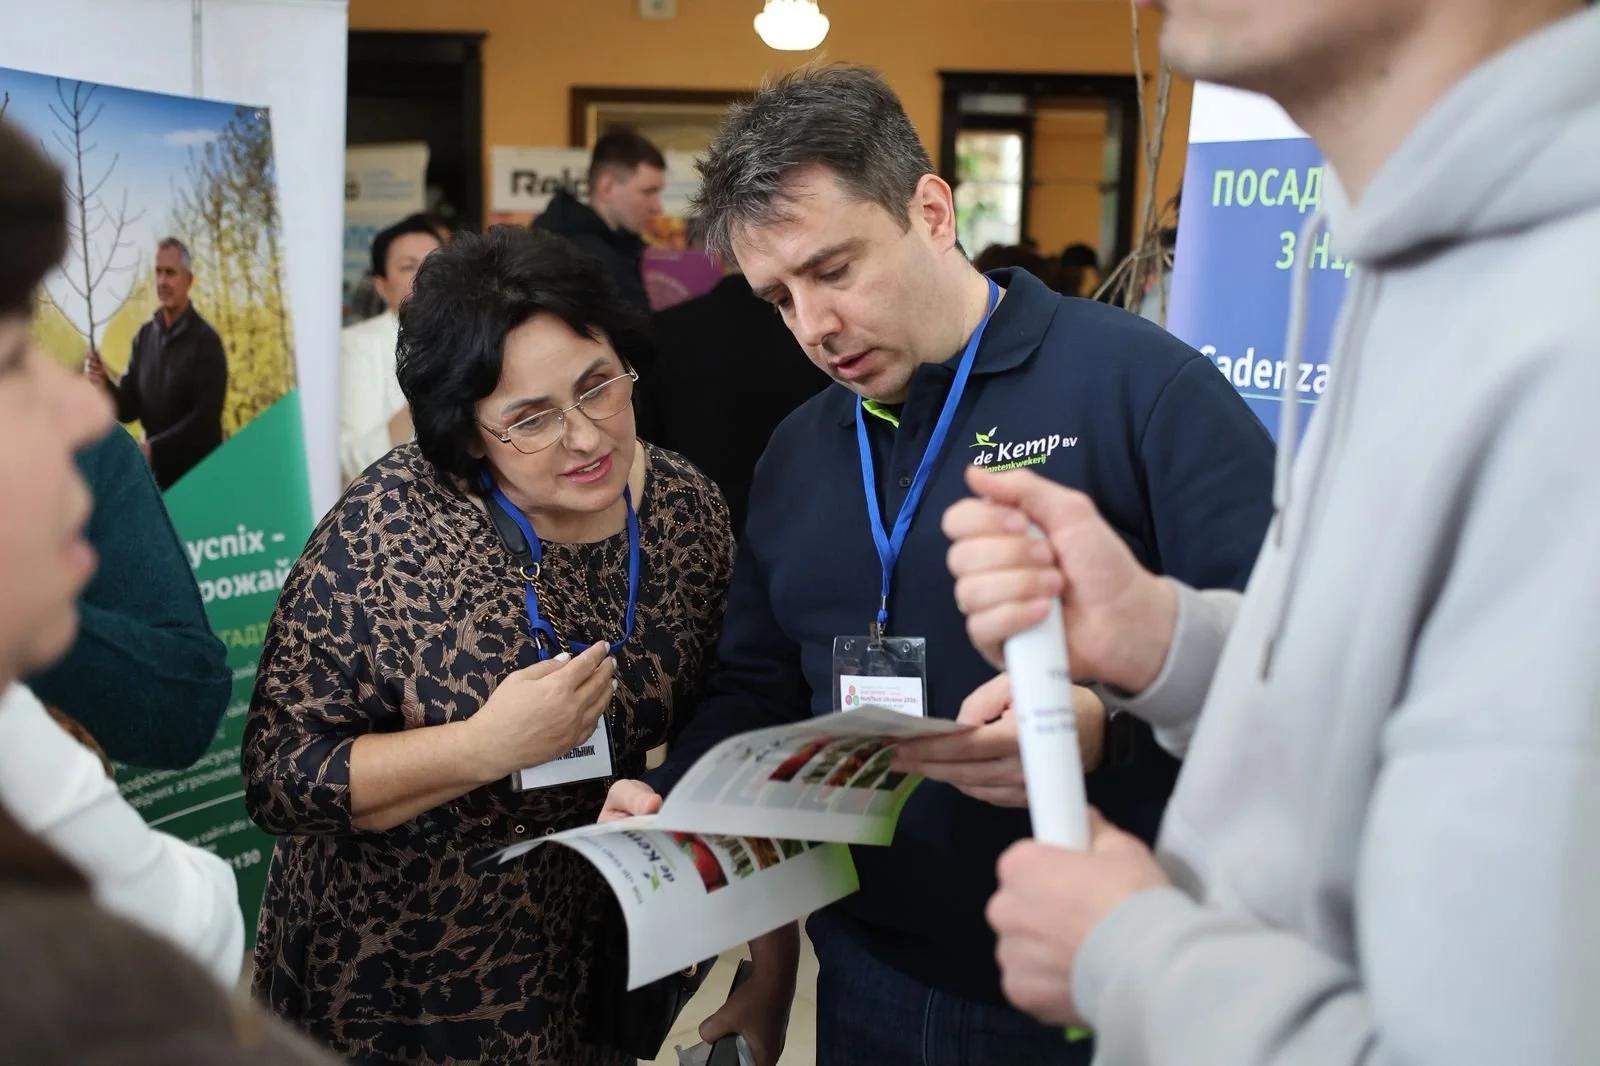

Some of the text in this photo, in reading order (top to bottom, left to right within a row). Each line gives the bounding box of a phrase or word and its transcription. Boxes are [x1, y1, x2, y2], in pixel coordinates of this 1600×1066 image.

[1212, 167, 1323, 213] ПОСАД
[973, 434, 1078, 466] de Kemp BV
[982, 454, 1047, 473] lantenkwekerij
[198, 558, 292, 603] рожай
